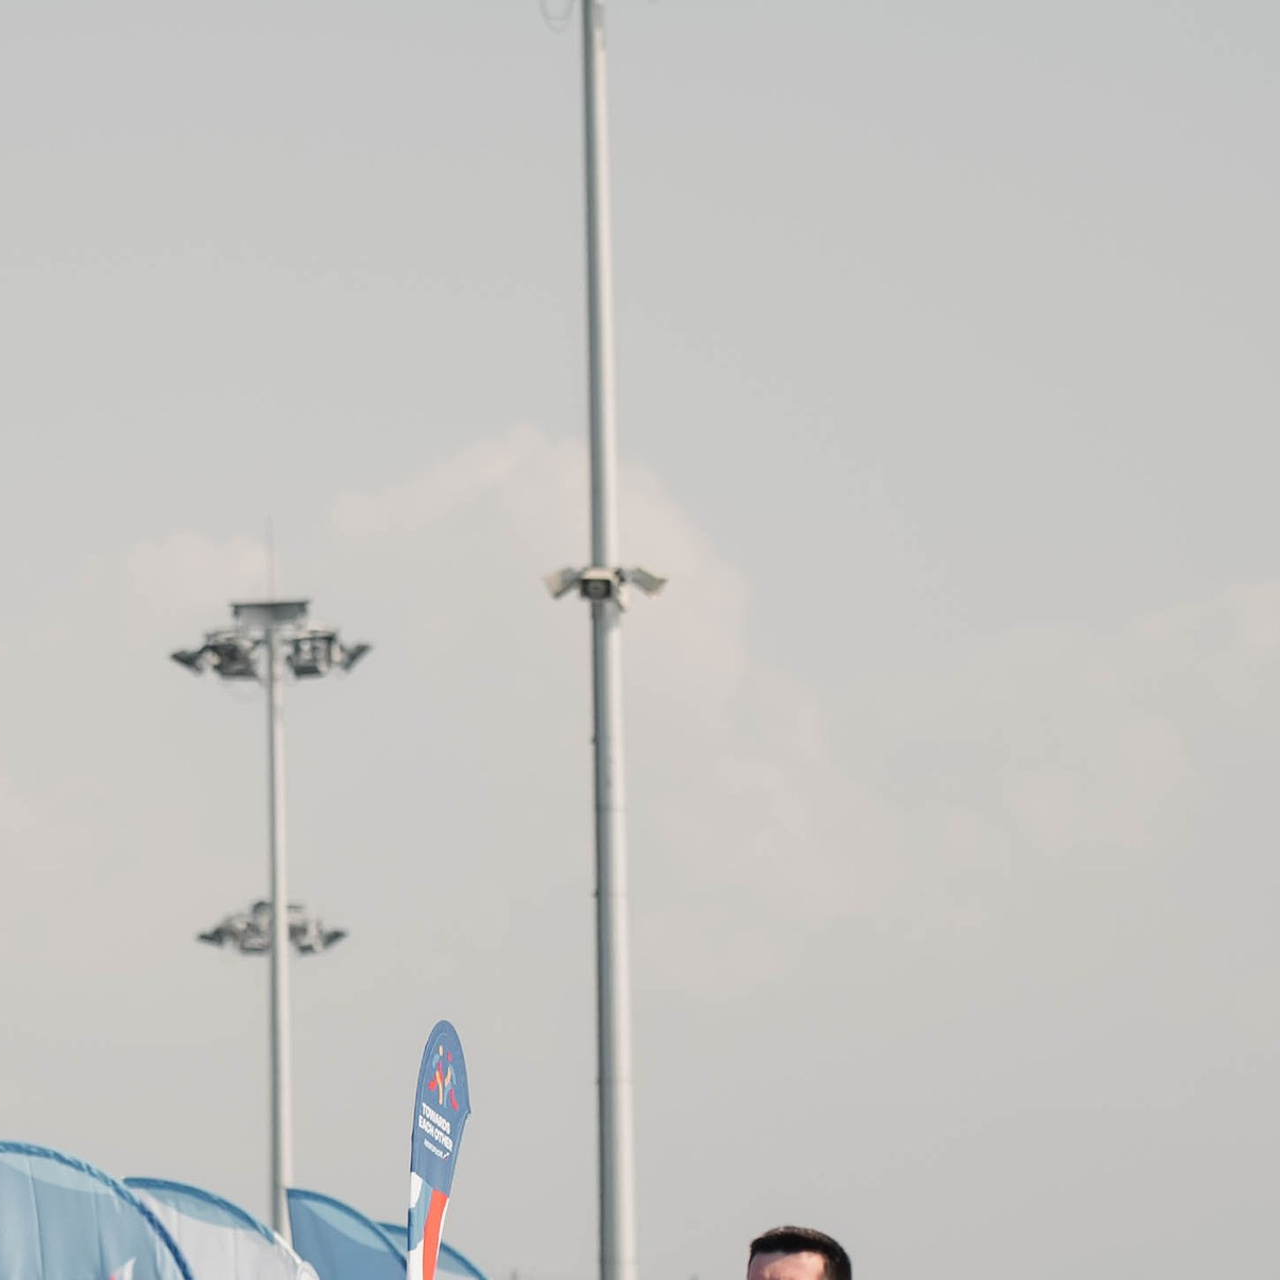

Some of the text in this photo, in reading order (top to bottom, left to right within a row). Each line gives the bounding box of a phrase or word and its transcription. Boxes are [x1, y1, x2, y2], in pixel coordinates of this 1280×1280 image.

[418, 1115, 453, 1152] EACH OTHER
[422, 1102, 450, 1135] TOWARDS
